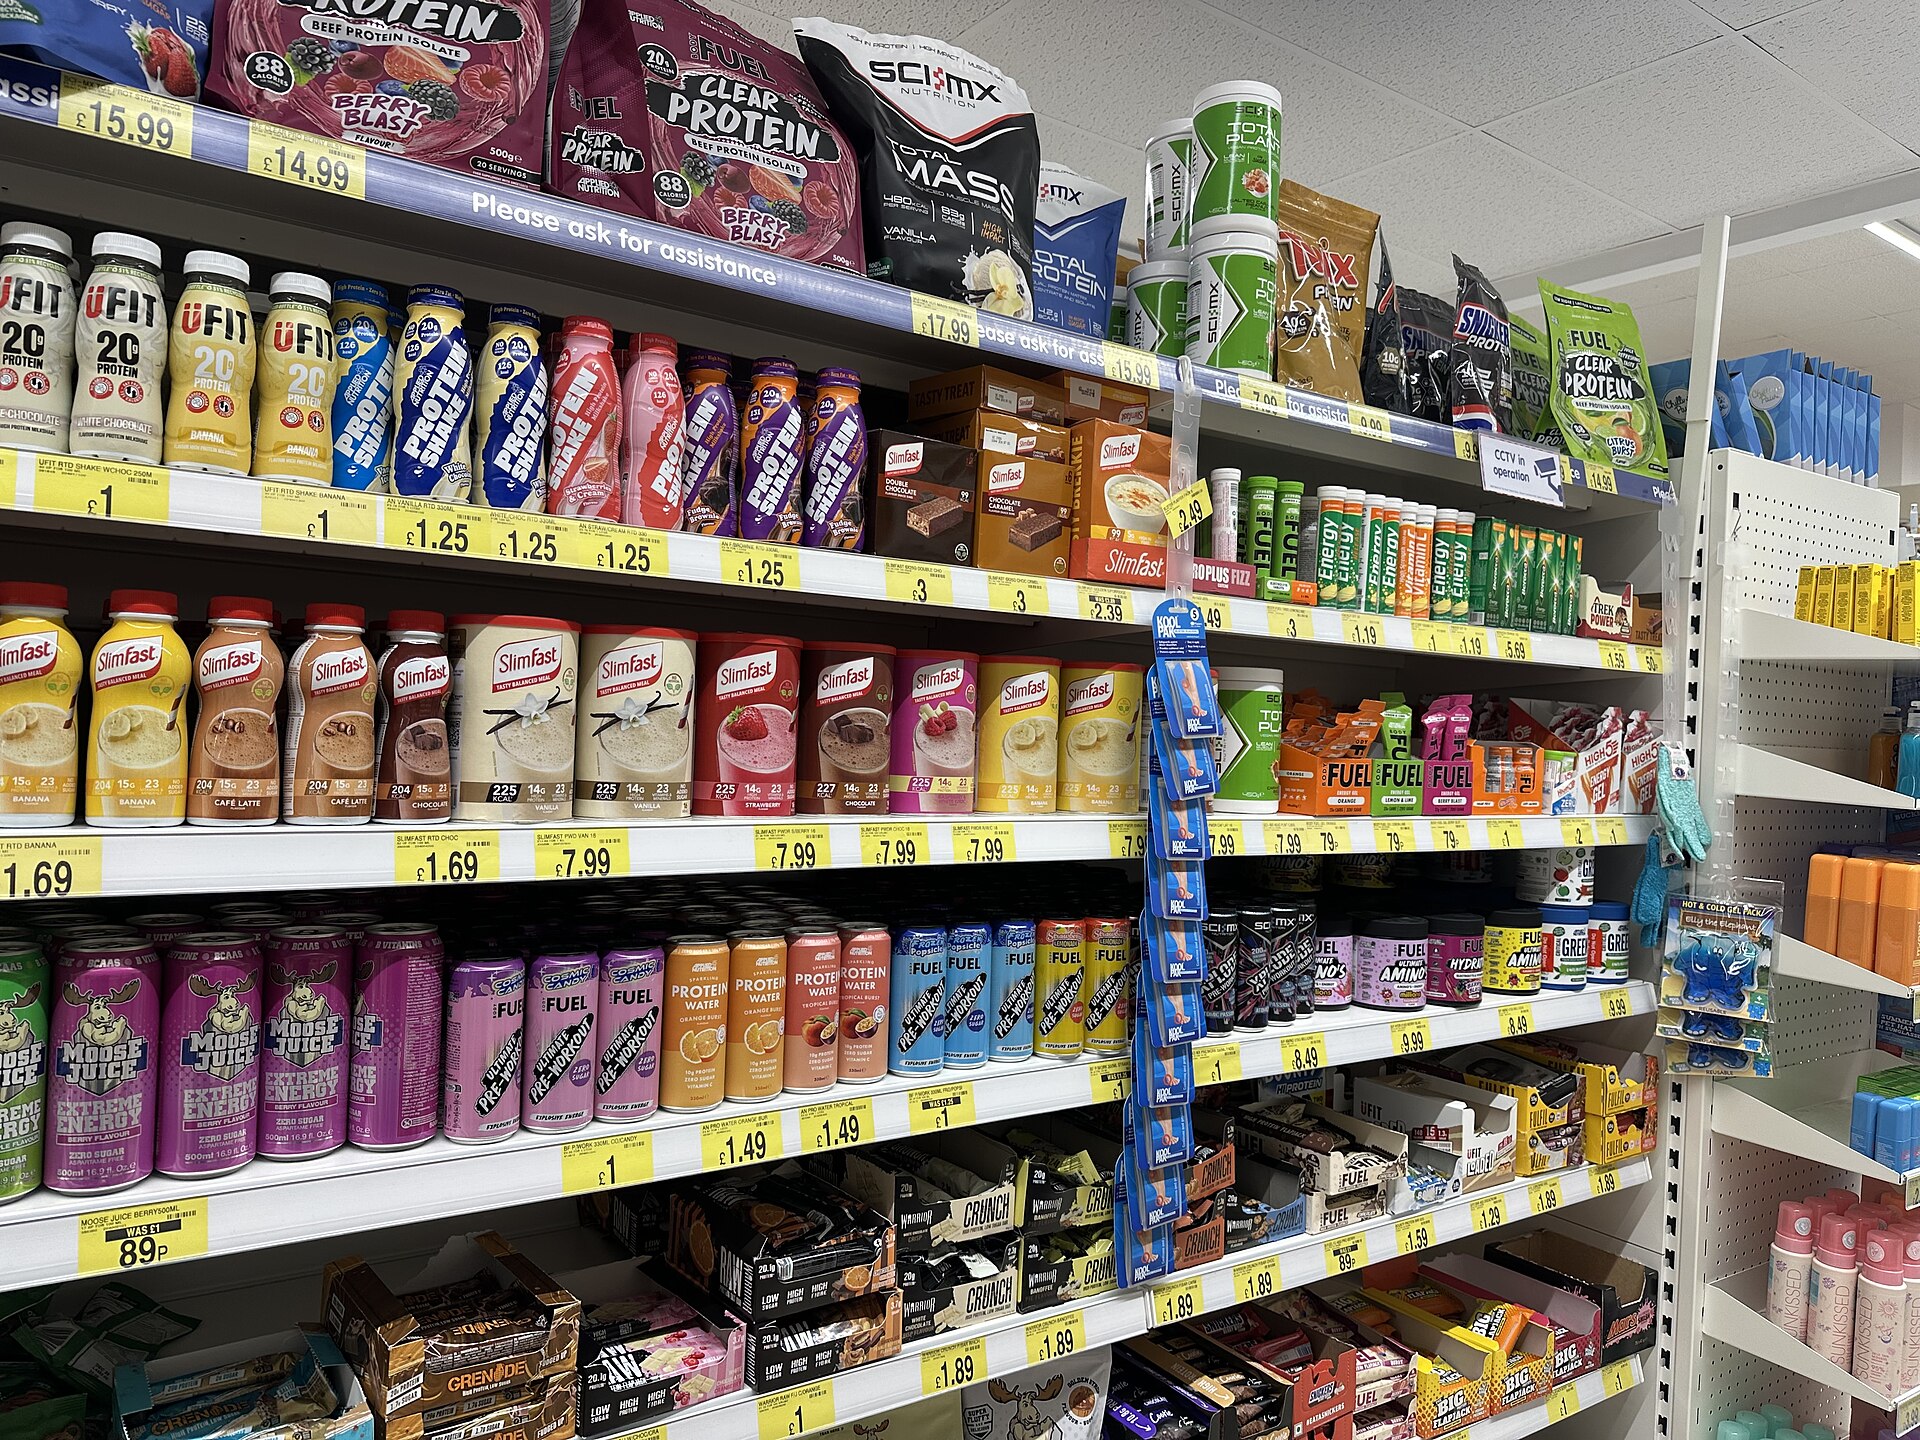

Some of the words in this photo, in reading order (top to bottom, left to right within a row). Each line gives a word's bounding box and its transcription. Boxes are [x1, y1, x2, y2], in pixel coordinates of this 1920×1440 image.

[311, 20, 343, 35] BEEF
[346, 26, 404, 43] PROTEIN
[407, 35, 462, 59] ISOLATE
[255, 56, 285, 75] 88
[252, 72, 289, 87] CALORIES
[699, 75, 778, 114] CLEAR
[900, 87, 977, 113] NUTRITION
[334, 96, 425, 124] BERRY
[76, 99, 174, 151] £15.99
[344, 109, 420, 137] BLAST
[668, 92, 820, 158] PROTEIN
[562, 138, 635, 172] PROTEIN
[263, 145, 350, 191] £14.99
[476, 159, 487, 168] 20
[490, 162, 528, 180] SERVINGS
[577, 184, 620, 198] NUTRITION
[472, 190, 560, 232] Please
[568, 216, 612, 246] ask
[618, 227, 654, 255] for
[659, 238, 777, 287] assistance
[883, 226, 937, 247] VANILLA
[86, 284, 158, 328] ÜFIT
[2, 321, 45, 356] 20g
[920, 318, 971, 344] £17.99
[1570, 329, 1611, 352] FUEL
[97, 331, 140, 366] 20g
[1019, 332, 1049, 353] ask
[1051, 341, 1079, 360] for
[2, 354, 44, 370] PROTEIN
[96, 364, 139, 378] PROTEIN
[1111, 355, 1151, 386] £15.99
[1575, 356, 1613, 373] CLEAR
[193, 378, 232, 394] PROTEIN
[1564, 371, 1634, 401] PROTEIN
[8, 411, 61, 428] CHOCOLATE
[77, 418, 101, 429] WHITE
[103, 419, 153, 436] CHOCOLATE
[190, 430, 225, 445] BANANA
[1606, 436, 1635, 451] CITRUS
[287, 444, 319, 459] BANANA
[1494, 450, 1515, 463] CCTV
[1517, 455, 1526, 466] in
[1611, 445, 1636, 458] BURST
[885, 478, 909, 488] DOUBLE
[1493, 466, 1530, 483] operation
[885, 485, 917, 497] CHOCOLATE
[87, 485, 113, 518] £1
[988, 503, 1014, 514] CARAMEL
[989, 496, 1021, 507] CHOCOLATE
[307, 509, 328, 540] £1
[406, 519, 469, 552] £1.25
[499, 530, 558, 563] £1.25
[597, 545, 651, 572] £1.25
[912, 578, 928, 603] £3
[1012, 590, 1027, 613] £3
[1591, 603, 1614, 617] TREK
[1090, 603, 1124, 623] £2.39
[1156, 616, 1182, 629] KOOL
[1591, 614, 1614, 628] POWER
[1158, 625, 1176, 638] PAK
[1459, 636, 1482, 656] £1.19
[1505, 641, 1526, 660] £5.69
[196, 780, 213, 790] 204
[246, 780, 260, 789] 23
[1327, 763, 1372, 788] FUEL
[1590, 768, 1610, 790] ENERGY
[492, 785, 517, 796] 225
[597, 783, 617, 793] 225
[656, 783, 670, 792] 23
[1591, 785, 1607, 806] GEL
[119, 798, 157, 806] BANANA
[214, 798, 236, 807] CAFÉ
[412, 801, 449, 809] CHOCOLATE
[634, 802, 661, 810] VANILLA
[844, 800, 876, 808] CHOCOLATE
[771, 842, 816, 869] £7.99
[876, 839, 916, 865] £7.99
[416, 850, 479, 885] £1.69
[556, 847, 611, 882] £7.99
[1682, 901, 1696, 909] HOT
[1706, 905, 1725, 913] COLD
[1727, 906, 1741, 914] GEL
[1743, 907, 1762, 916] PACK
[1685, 915, 1702, 927] Elly
[1703, 917, 1717, 927] the
[1719, 919, 1757, 933] Elephant
[910, 945, 944, 956] Popsicle
[87, 957, 122, 968] BCAAS
[613, 989, 653, 1005] FUEL
[808, 986, 837, 996] WATER
[545, 996, 588, 1012] FUEL
[685, 1000, 720, 1010] WATER
[1608, 998, 1627, 1018] £9.99
[270, 1015, 340, 1037] MOOSE
[679, 1015, 703, 1023] ORANGE
[1880, 1014, 1915, 1027] SUMMER
[1880, 1020, 1895, 1029] PET
[1896, 1022, 1913, 1031] HAT
[61, 1039, 144, 1063] MOOSE
[272, 1034, 335, 1056] JUICE
[1400, 1031, 1423, 1052] £9.99
[1292, 1048, 1318, 1070] £8.49
[67, 1058, 137, 1083] JUICE
[265, 1066, 340, 1085] EXTREME
[264, 1083, 337, 1102] ENERGY
[56, 1092, 143, 1116] EXTREME
[274, 1102, 297, 1110] BERRY
[298, 1099, 329, 1108] FLAVOUR
[1360, 1101, 1382, 1117] UFIT
[55, 1109, 141, 1133] ENERGY
[275, 1117, 298, 1126] ZERO
[300, 1115, 324, 1124] SUGAR
[1529, 1111, 1548, 1129] FULFIL
[68, 1135, 93, 1144] BERRY
[95, 1129, 130, 1141] FLAVOUR
[816, 1115, 860, 1148] £1.49
[719, 1129, 767, 1166] £1.49
[598, 1155, 615, 1186] £1
[1596, 1172, 1615, 1193] £1.89
[1537, 1189, 1557, 1211] £1.89
[81, 1217, 110, 1227] MOOSE
[110, 1214, 132, 1222] JUICE
[133, 1204, 180, 1220] BERRY500ML
[963, 1192, 1011, 1229] CRUNCH
[126, 1226, 149, 1237] WAS
[150, 1223, 160, 1234] £1
[966, 1276, 1013, 1313] CRUNCH
[1039, 1329, 1075, 1361] £1.89
[935, 1355, 975, 1389] £1.89
[590, 1404, 612, 1417] LOW
[619, 1397, 640, 1410] HIGH
[1438, 1390, 1466, 1416] BIG
[1432, 1405, 1471, 1430] FLAPJACK
